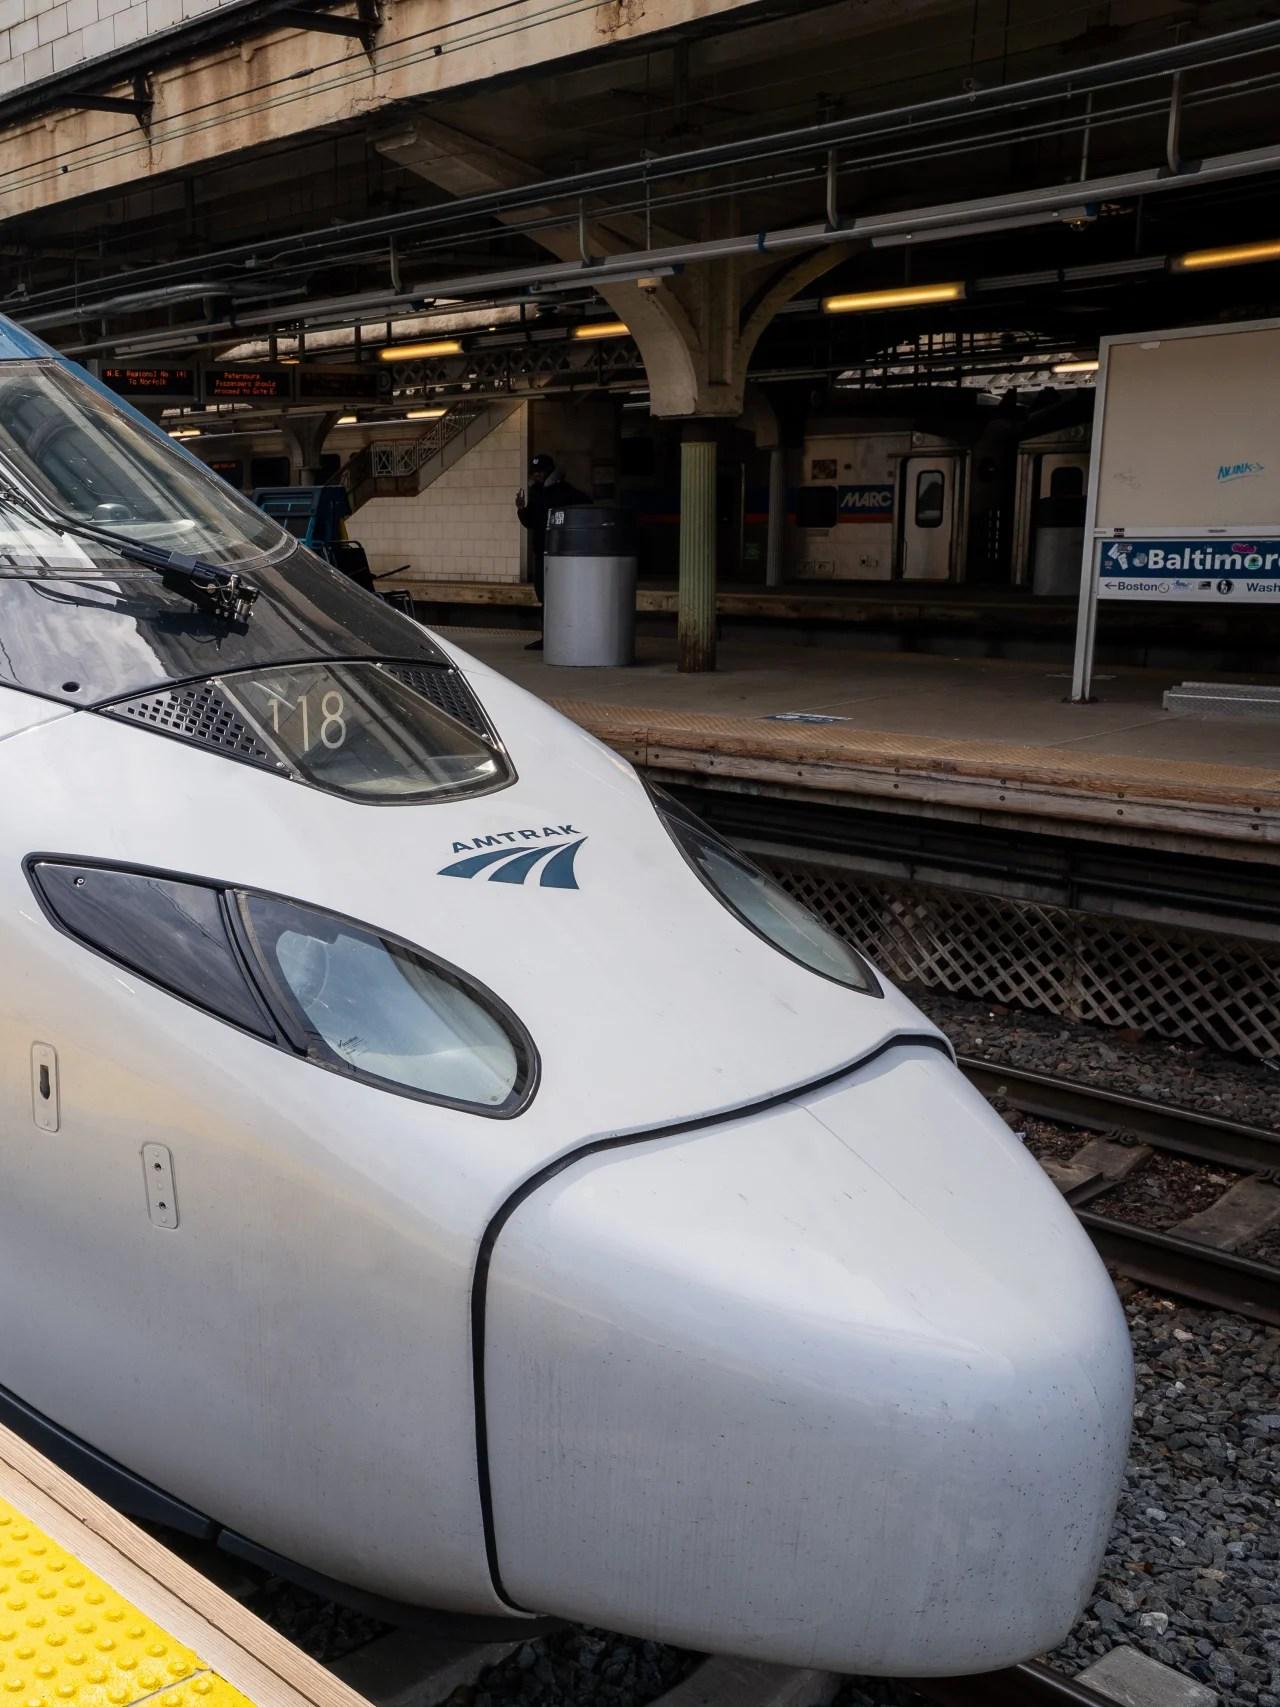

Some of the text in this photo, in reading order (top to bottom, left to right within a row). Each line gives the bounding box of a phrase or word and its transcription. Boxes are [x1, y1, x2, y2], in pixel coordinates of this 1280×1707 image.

[841, 491, 892, 508] MARC
[1148, 547, 1280, 571] Baltimor
[1118, 581, 1158, 592] Boston
[267, 690, 347, 752] 118
[451, 824, 581, 853] AMTRAK
